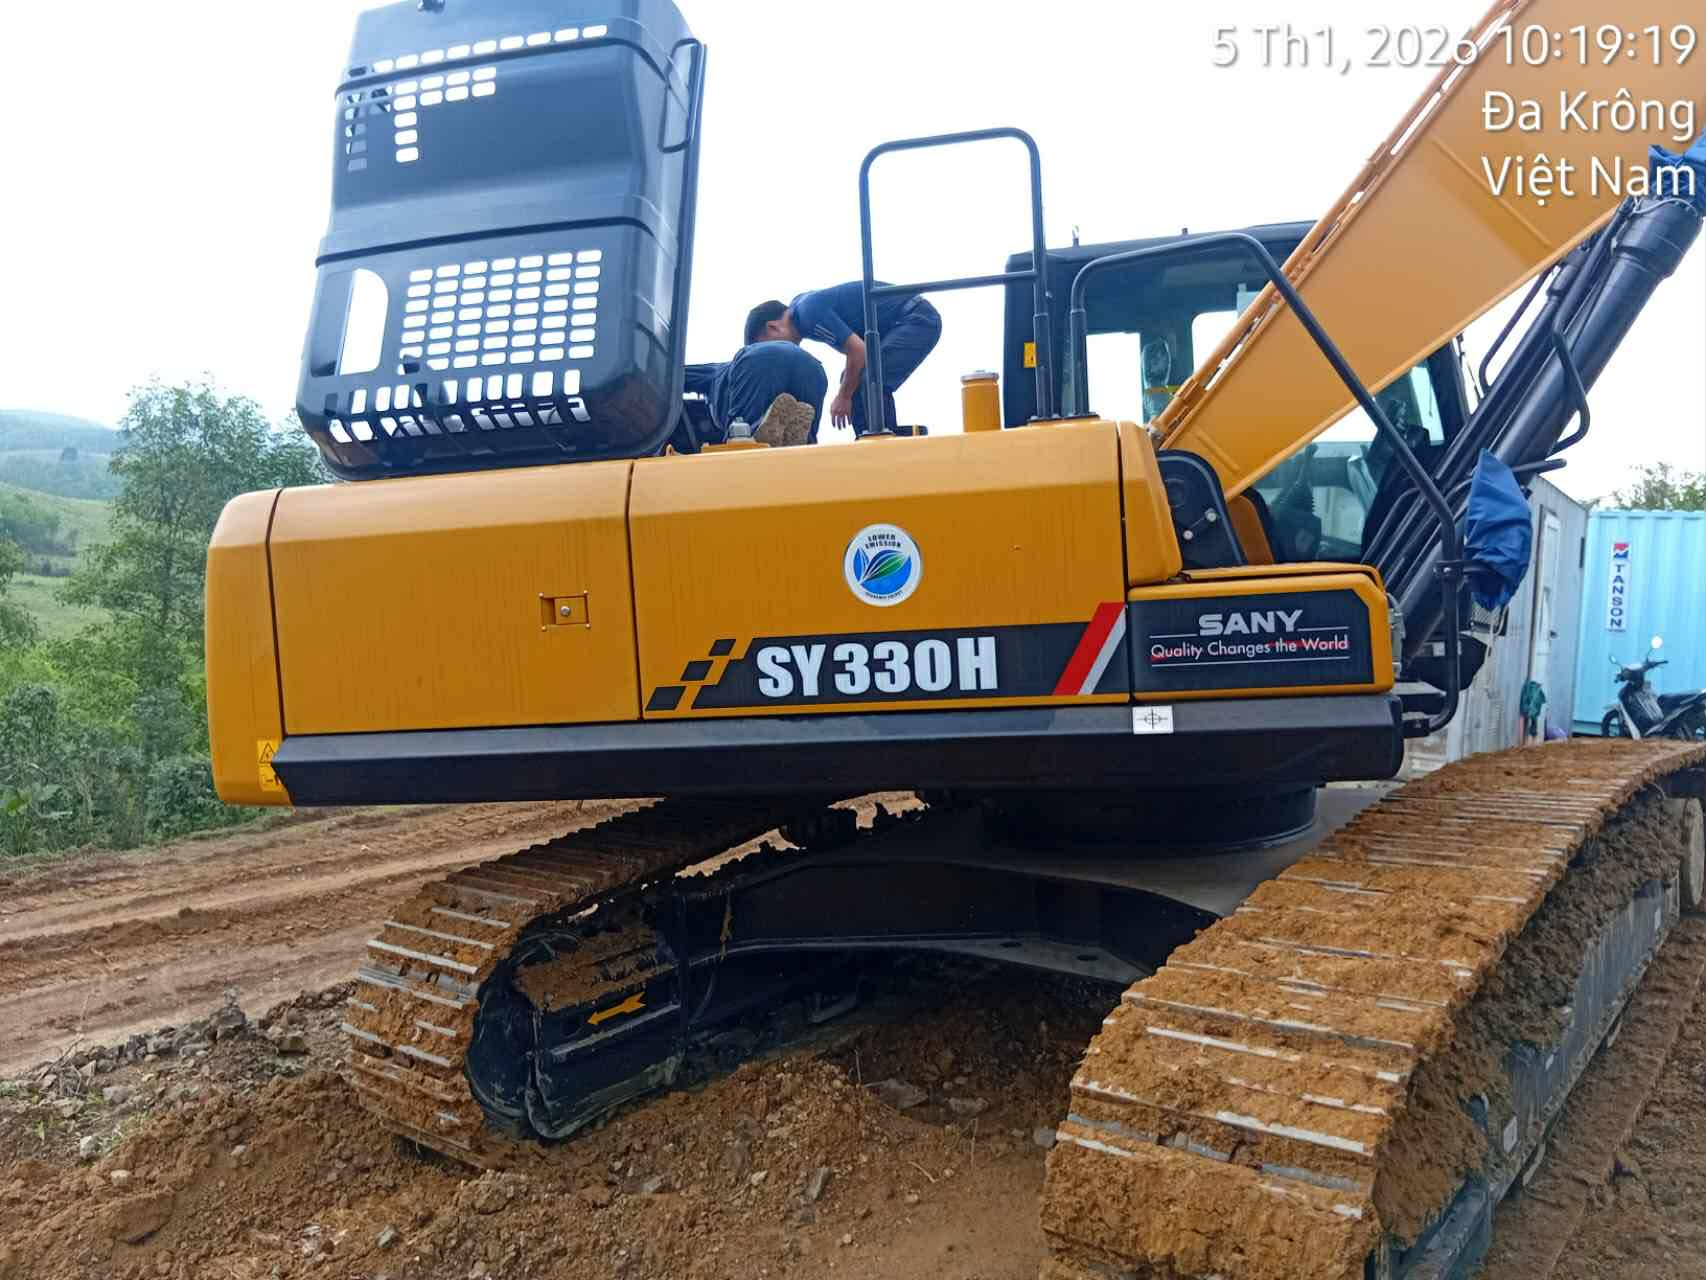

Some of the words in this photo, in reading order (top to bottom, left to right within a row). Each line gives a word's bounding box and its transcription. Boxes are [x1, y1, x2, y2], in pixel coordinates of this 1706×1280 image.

[1610, 564, 1625, 627] TANSON
[1199, 609, 1303, 636] SANY
[756, 636, 998, 698] SY330H
[1151, 643, 1203, 660] Quality
[1207, 640, 1271, 658] Changes
[1275, 637, 1297, 652] the
[1301, 634, 1349, 650] World
